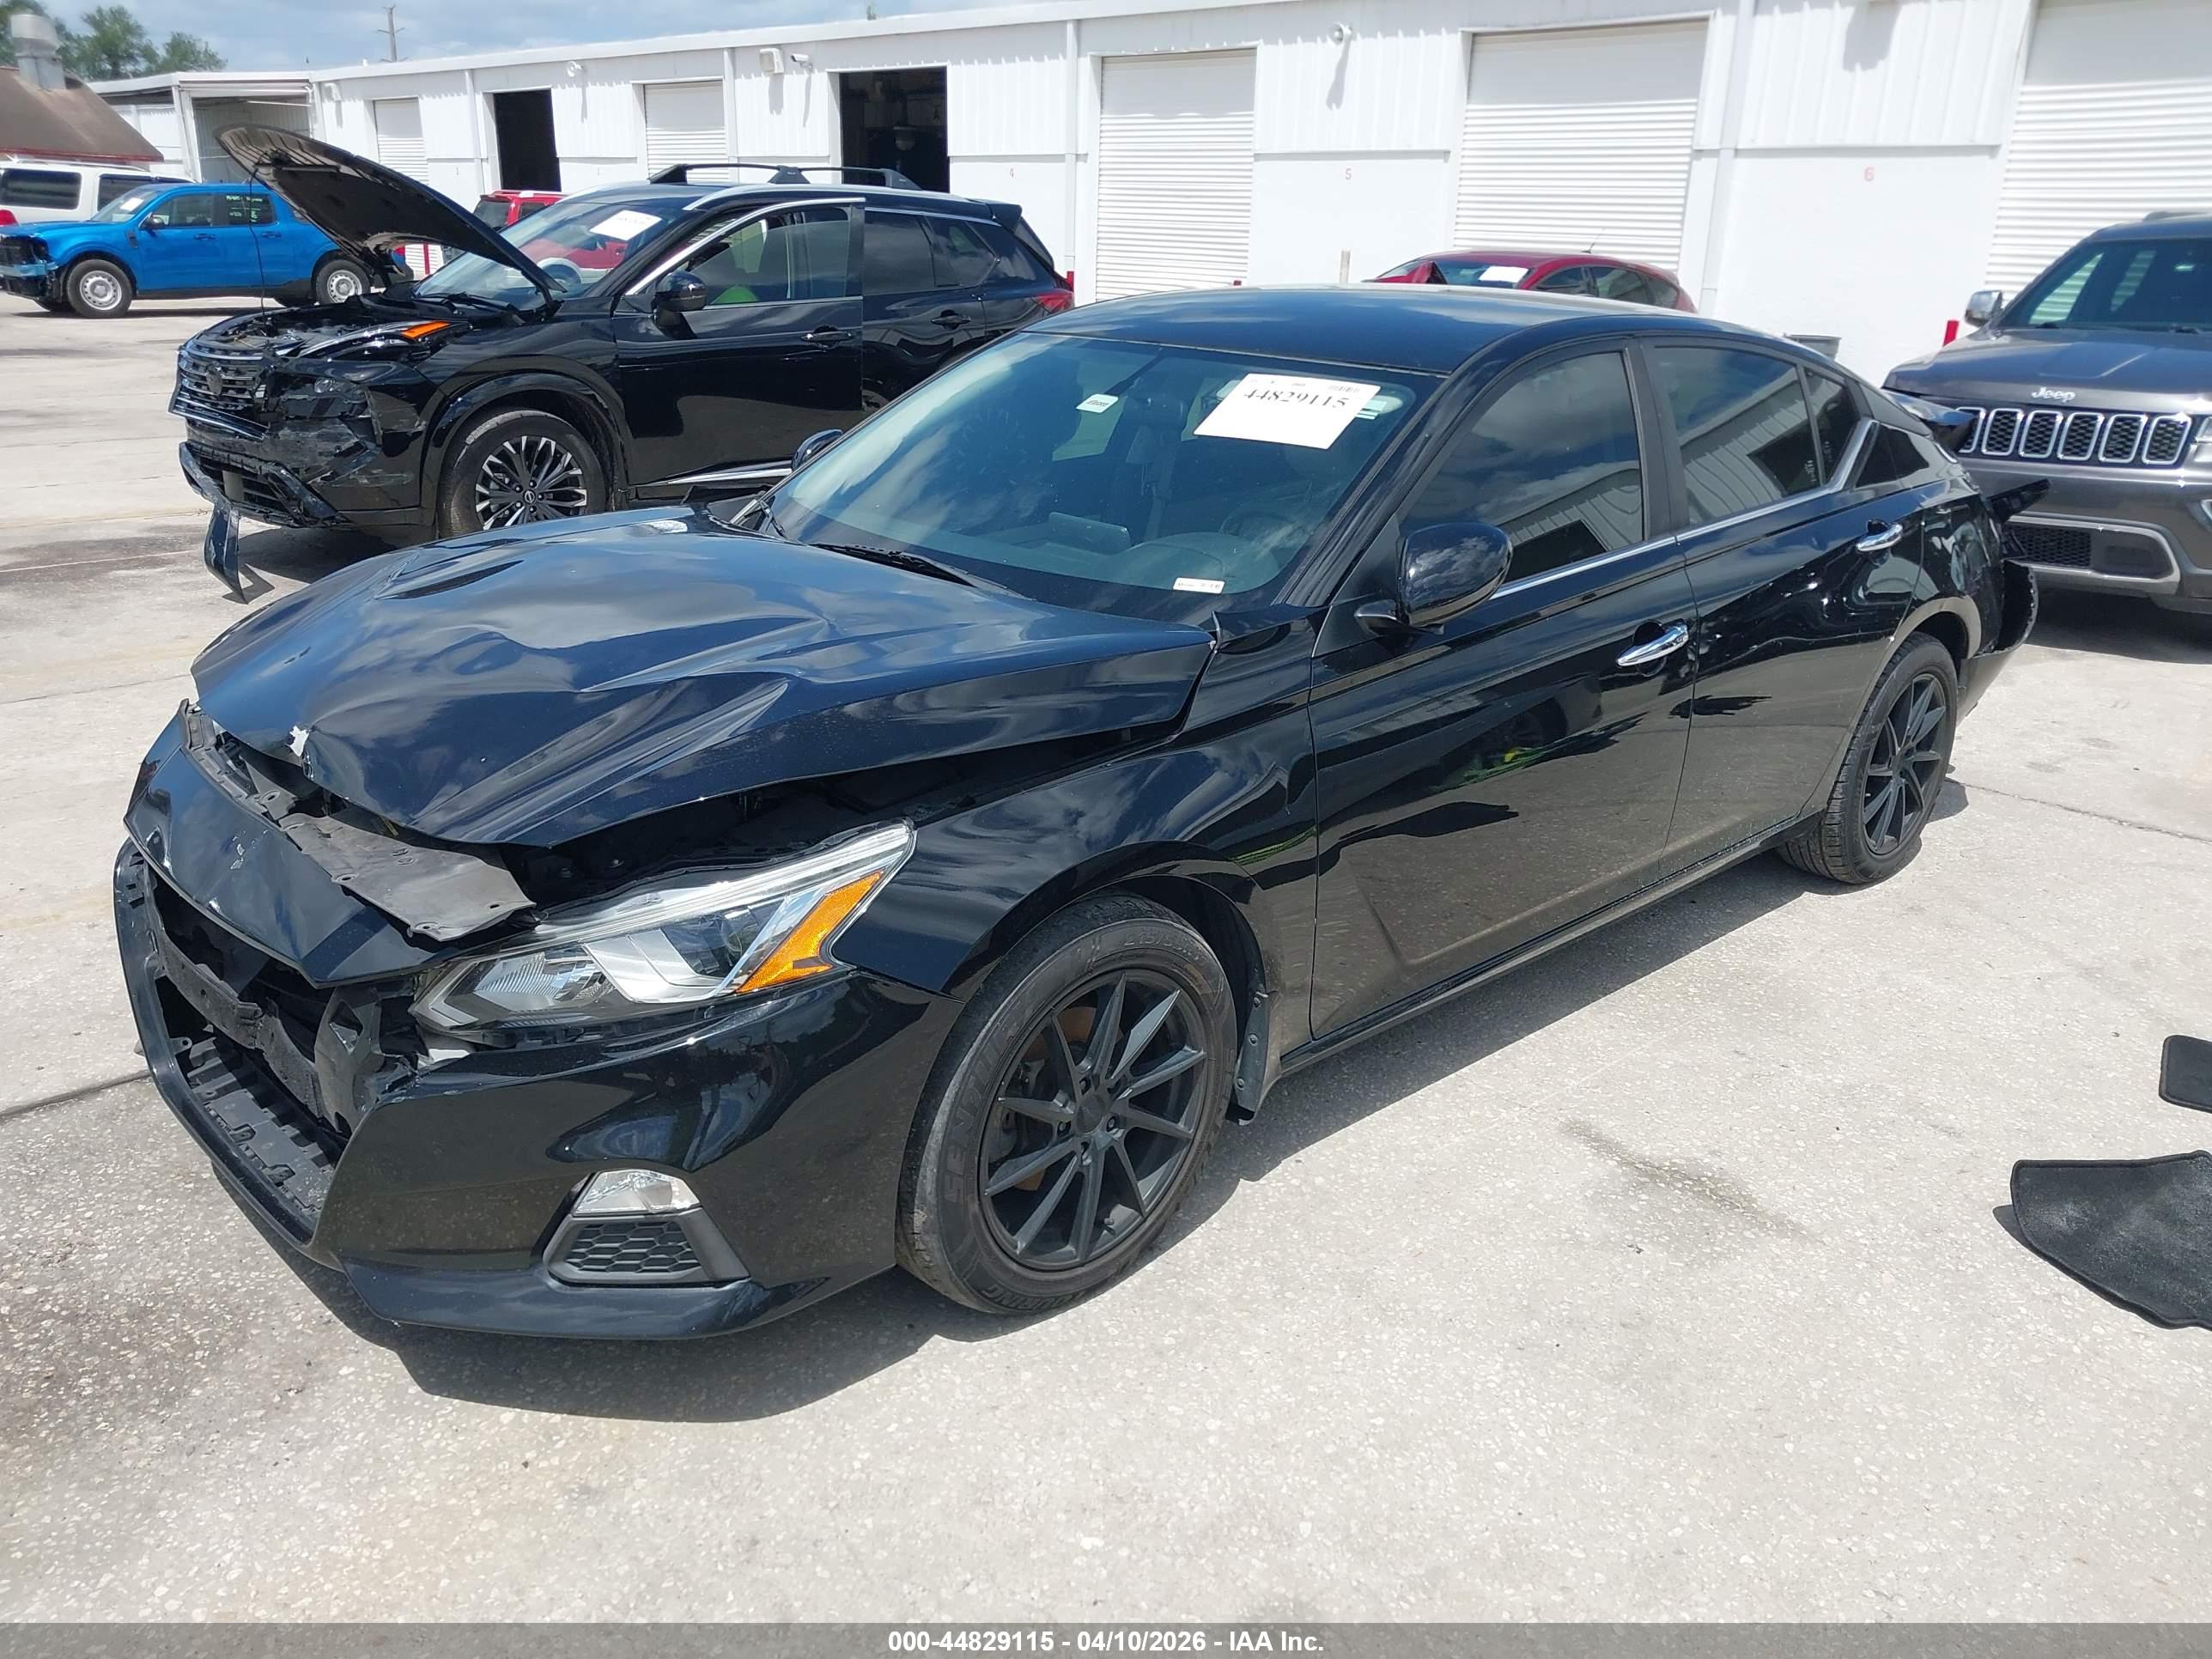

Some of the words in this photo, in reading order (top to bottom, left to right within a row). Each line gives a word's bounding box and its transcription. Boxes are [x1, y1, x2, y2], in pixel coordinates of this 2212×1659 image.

[1346, 167, 1352, 180] 5
[1864, 167, 1875, 181] 6
[1244, 389, 1349, 408] 44829115
[2032, 386, 2075, 403] Jeep
